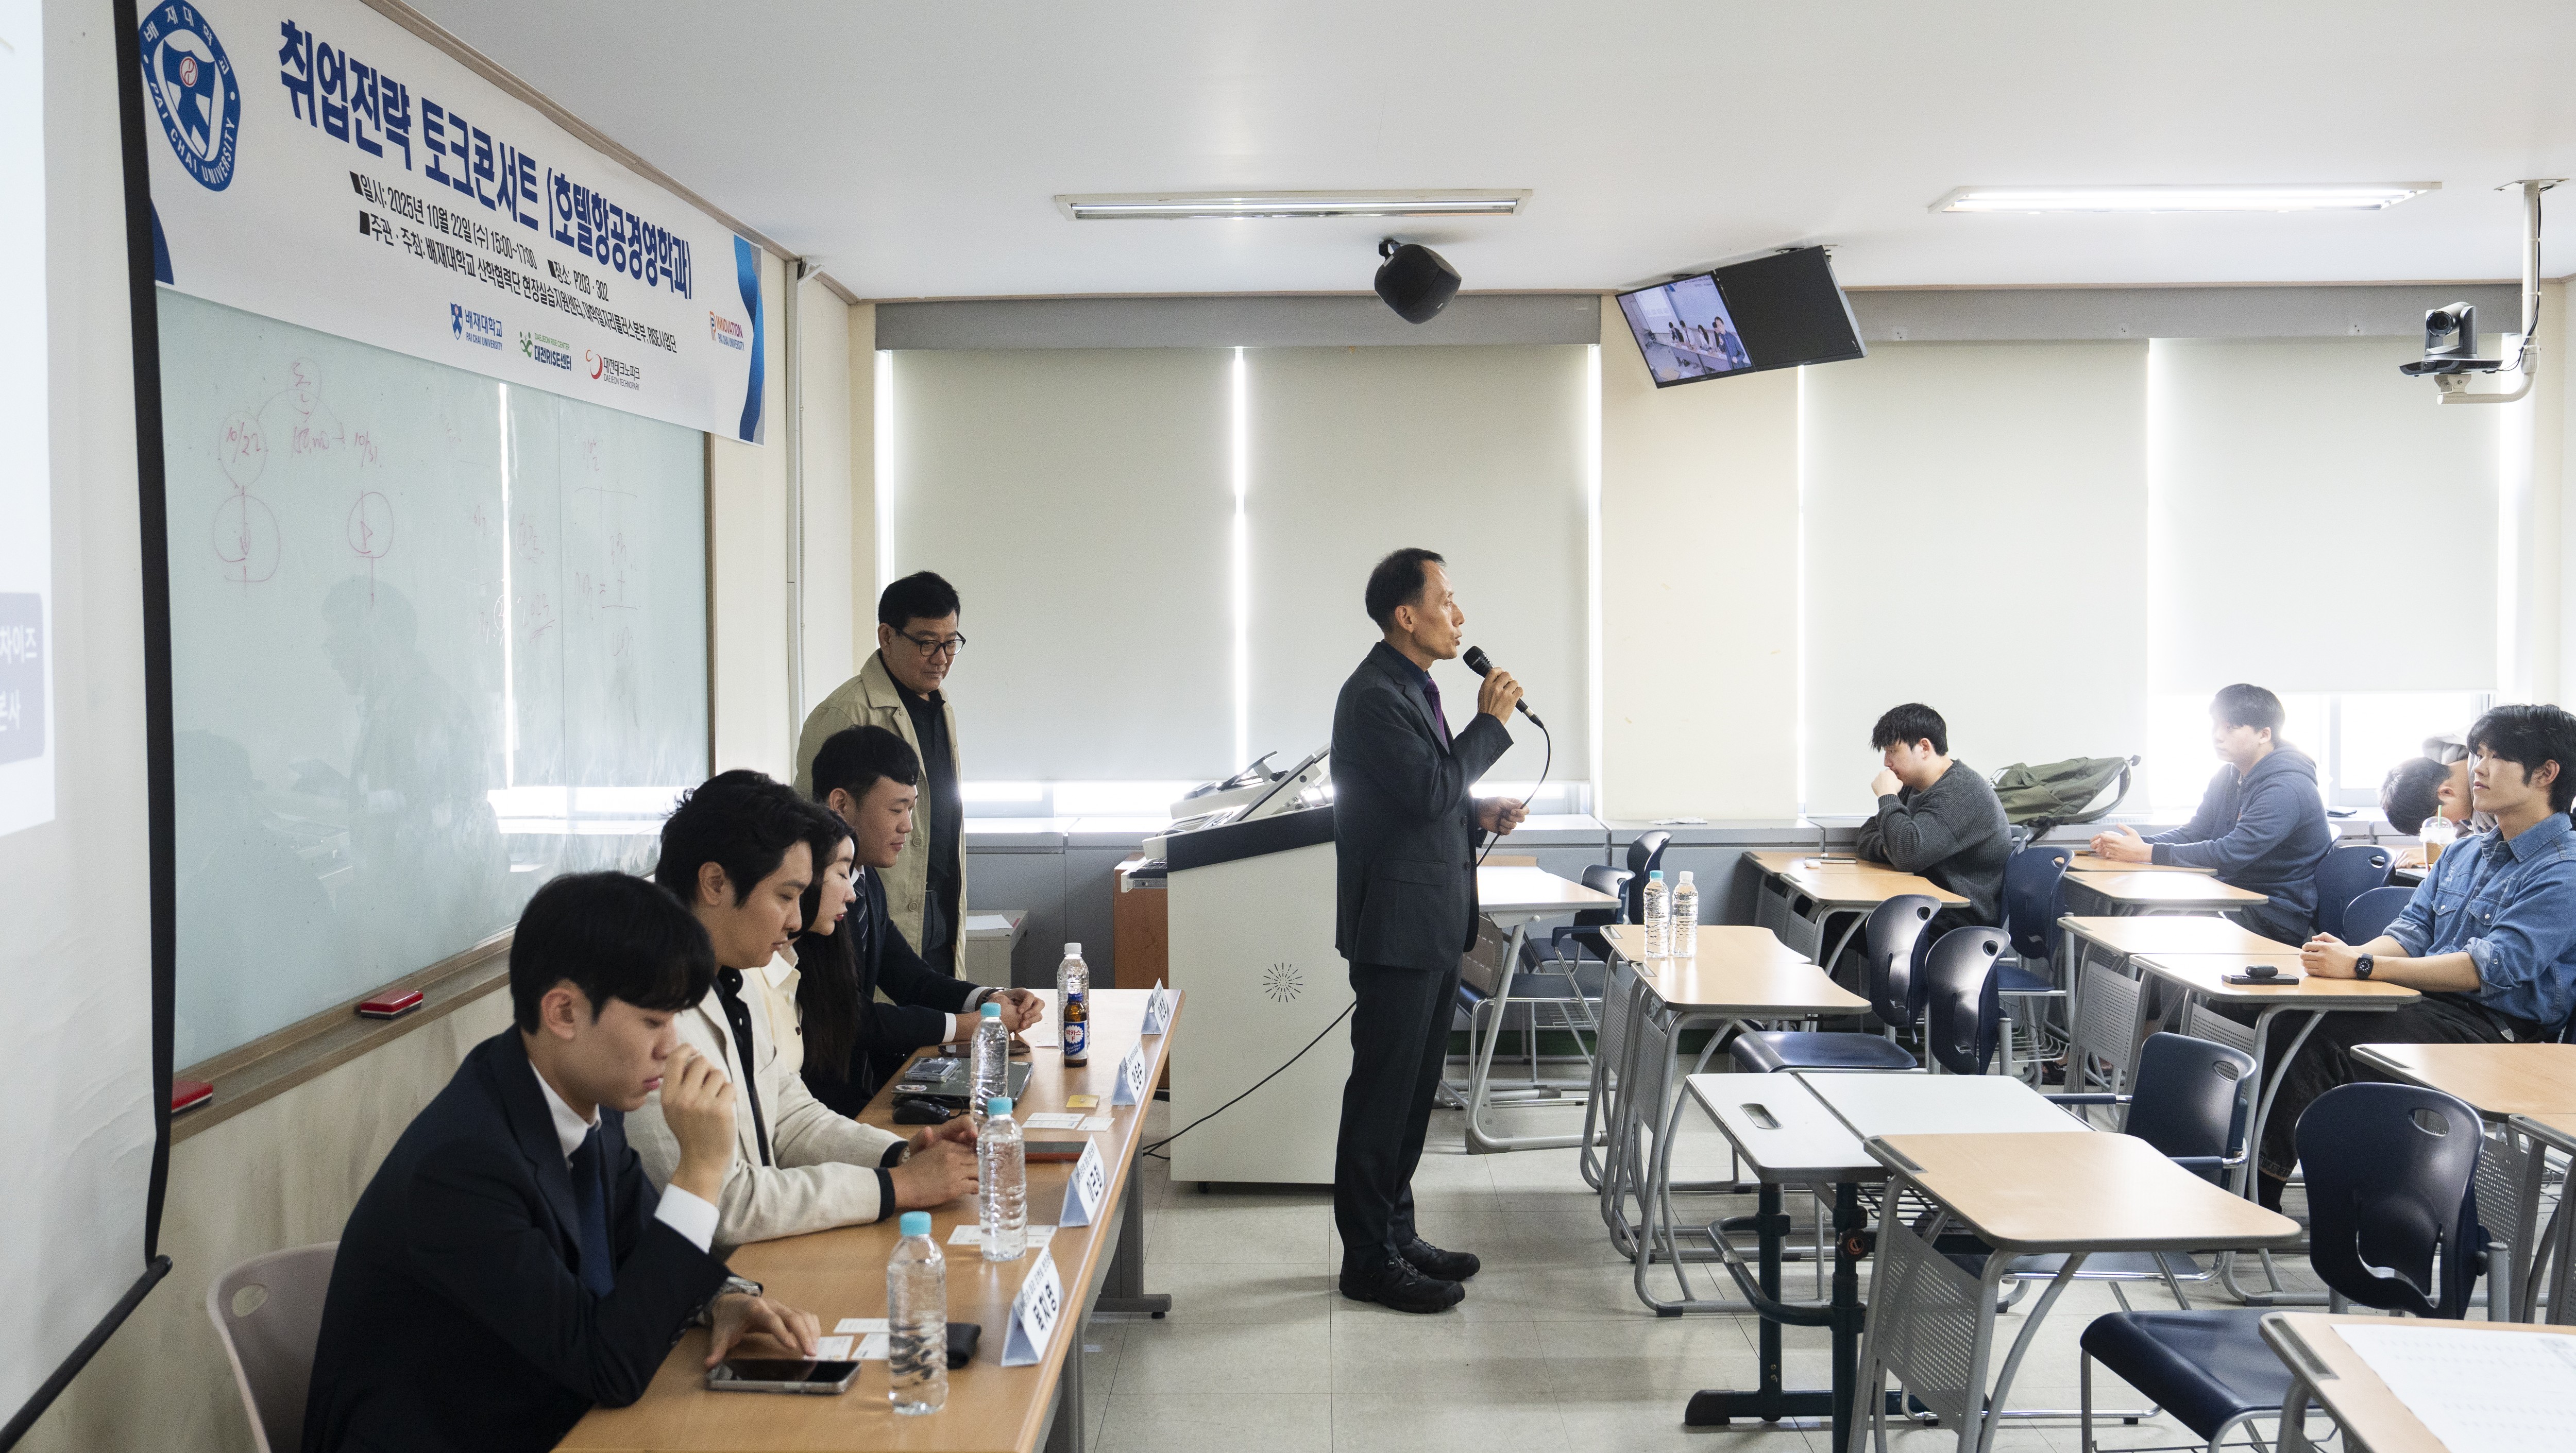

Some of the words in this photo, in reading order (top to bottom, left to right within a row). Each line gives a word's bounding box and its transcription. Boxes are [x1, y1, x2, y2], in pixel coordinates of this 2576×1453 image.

[143, 5, 230, 75] 배재대학교
[150, 82, 169, 119] PAI
[170, 128, 197, 173] CHAI
[201, 116, 235, 184] UNIVERSITY
[278, 19, 412, 172] 취업전략
[421, 96, 539, 231] 토크콘서트
[546, 167, 692, 300] (호텔항공경영학과)
[360, 174, 387, 208] 일시:
[387, 186, 425, 225] 2025년
[427, 203, 450, 235] 10월
[451, 212, 472, 244] 22일
[473, 221, 489, 250] (수)
[490, 230, 537, 270] 15:00~17:00
[370, 213, 395, 247] 주관
[400, 227, 426, 260] 주최:
[425, 236, 477, 278] 배재대학교
[477, 257, 521, 296] 산학협력단
[553, 260, 571, 286] 장소:
[573, 269, 591, 295] P203
[596, 279, 609, 302] 302
[464, 309, 503, 338] 배재대학교
[715, 315, 743, 339] INNOVATION
[534, 345, 572, 371] 대전RISE센터
[603, 356, 640, 381] 대전테크노파크
